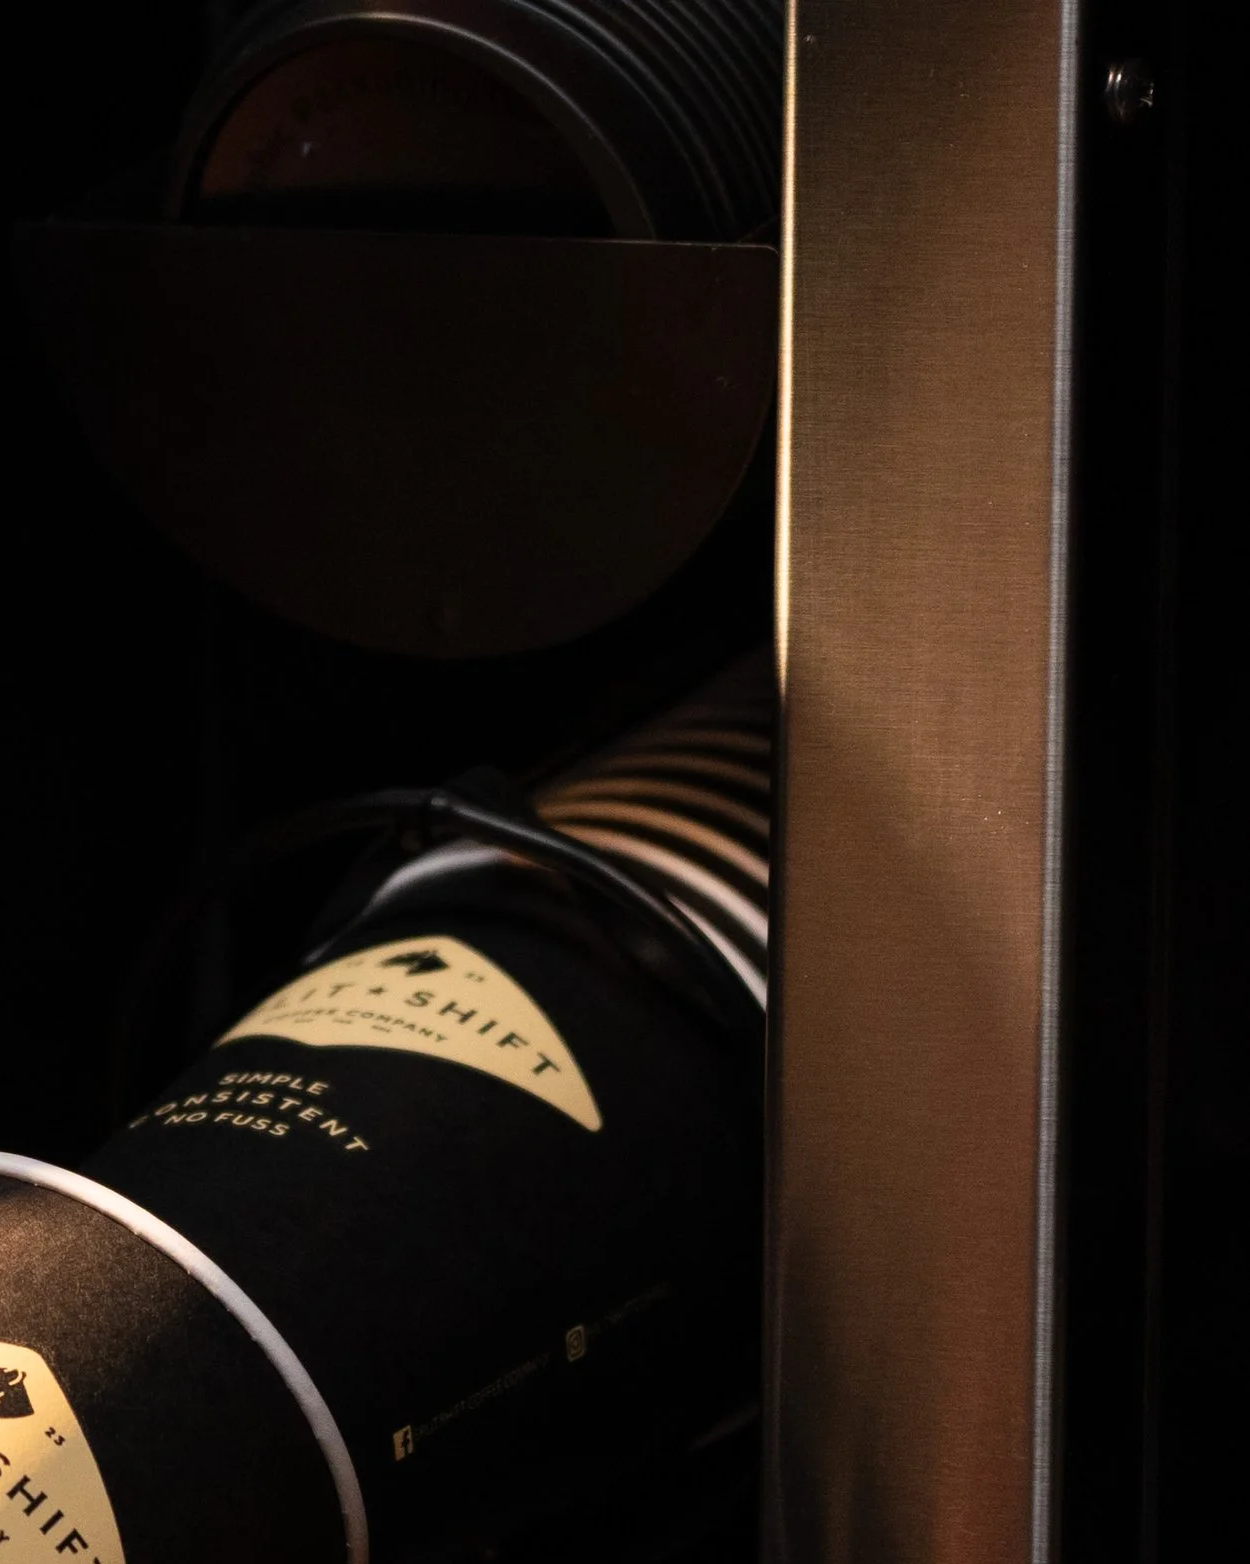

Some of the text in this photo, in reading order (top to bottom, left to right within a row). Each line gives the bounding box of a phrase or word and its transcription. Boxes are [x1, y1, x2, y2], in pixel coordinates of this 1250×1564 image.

[344, 1008, 447, 1043] COMPANY
[404, 990, 561, 1076] SHIFT
[218, 1070, 330, 1097] SIMPLE
[163, 1110, 291, 1137] NO FUSS
[44, 1426, 67, 1447] 23
